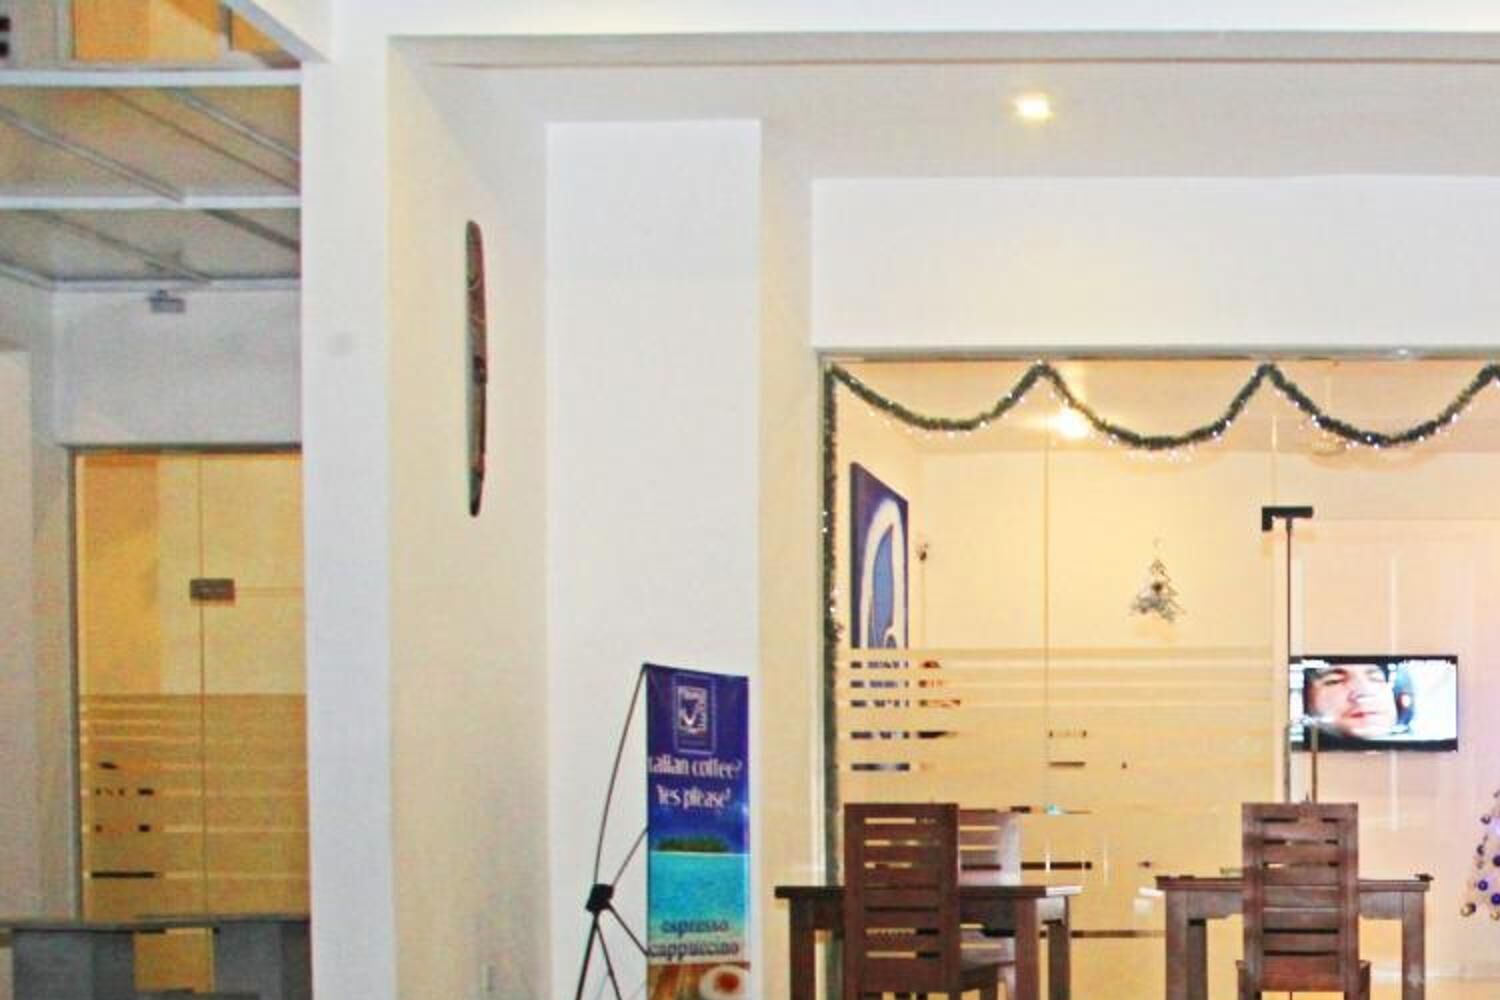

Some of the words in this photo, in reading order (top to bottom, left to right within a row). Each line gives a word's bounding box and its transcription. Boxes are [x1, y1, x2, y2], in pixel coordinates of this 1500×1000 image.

[656, 784, 681, 806] Yes
[662, 919, 729, 938] espresso
[648, 942, 739, 961] cappuccino
